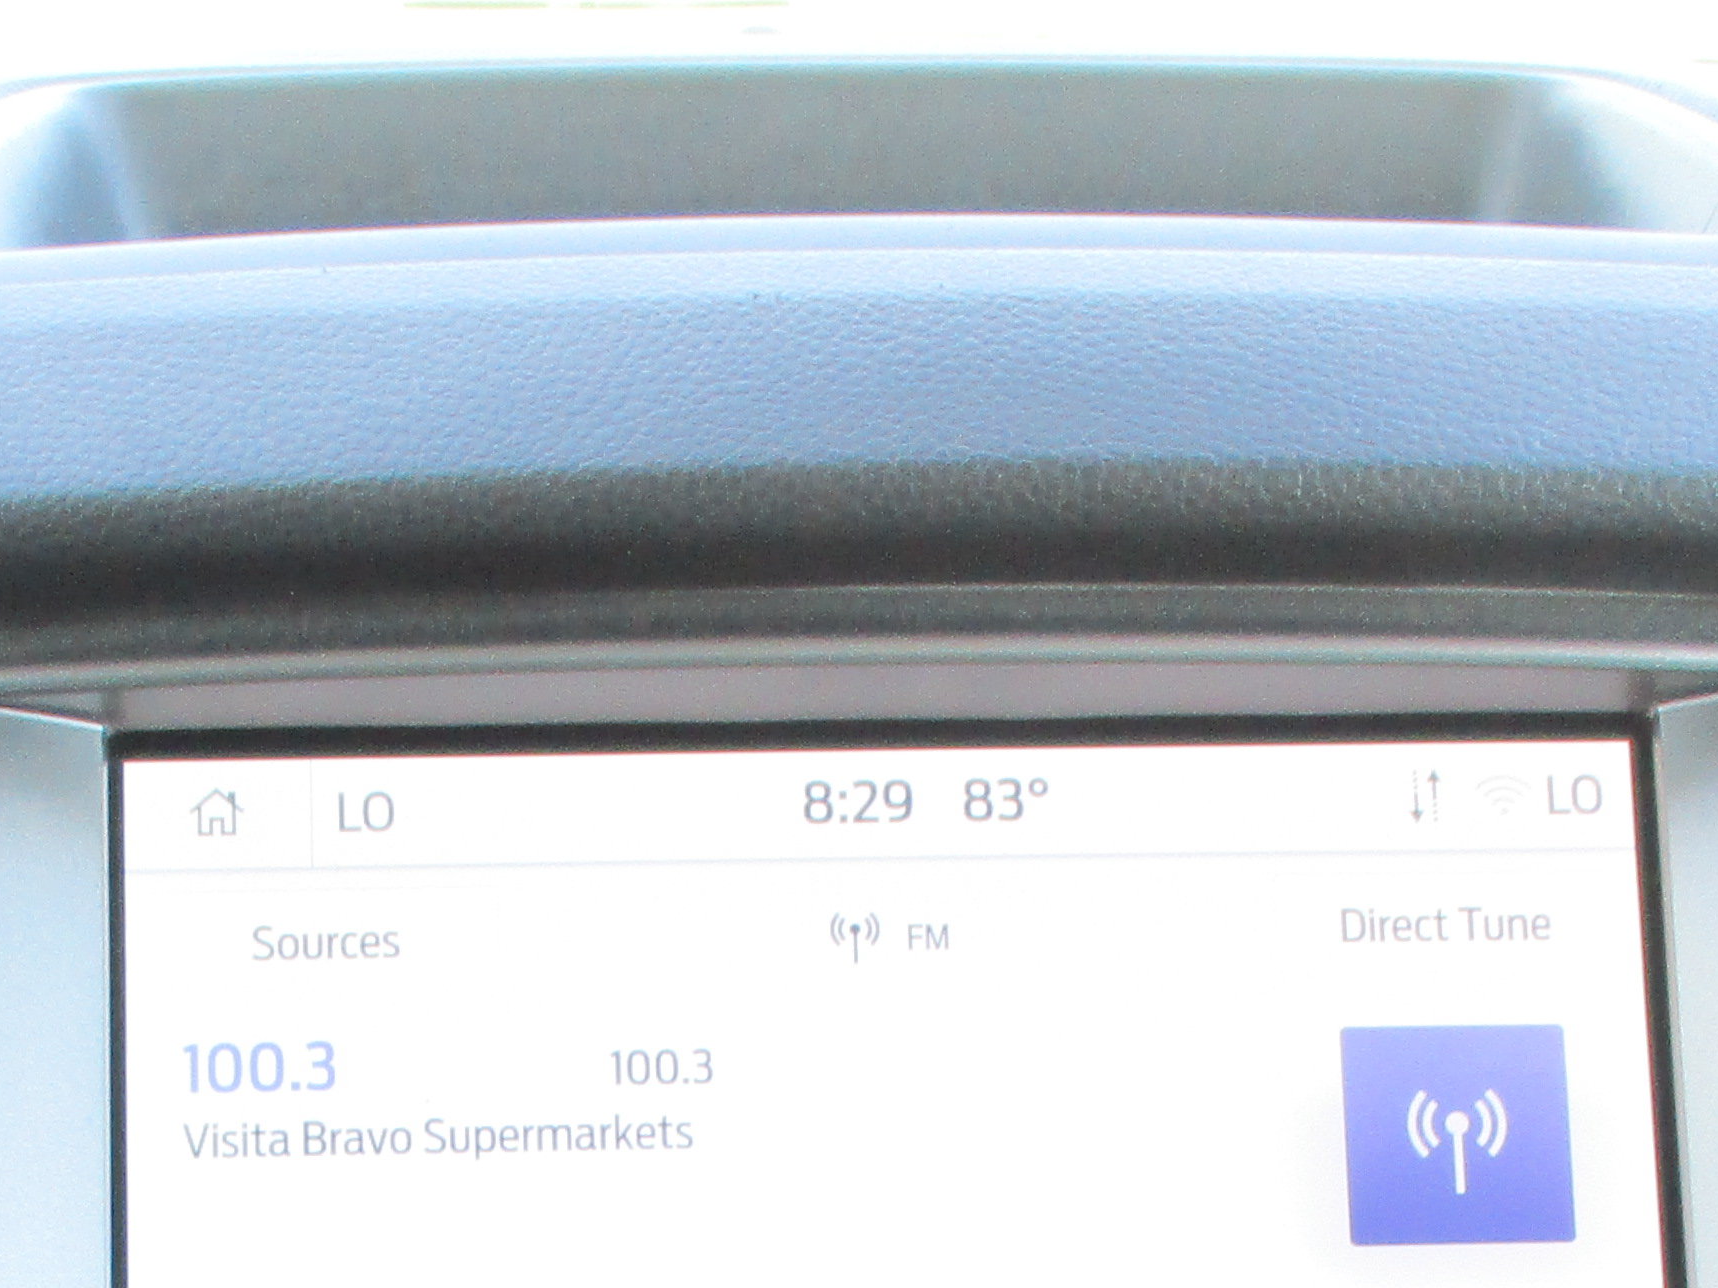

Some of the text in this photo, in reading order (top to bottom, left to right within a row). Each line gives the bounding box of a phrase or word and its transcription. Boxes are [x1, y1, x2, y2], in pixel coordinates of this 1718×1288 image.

[338, 790, 395, 833] LO
[803, 779, 914, 824] 8:29
[1546, 773, 1603, 815] LO
[252, 924, 401, 961] Sources
[907, 923, 949, 950] FM
[1340, 905, 1552, 943] Direct Tune
[183, 1040, 336, 1093] 100.3
[611, 1047, 714, 1085] 100.3
[183, 1113, 694, 1160] Visita Bravo Supermarkets
